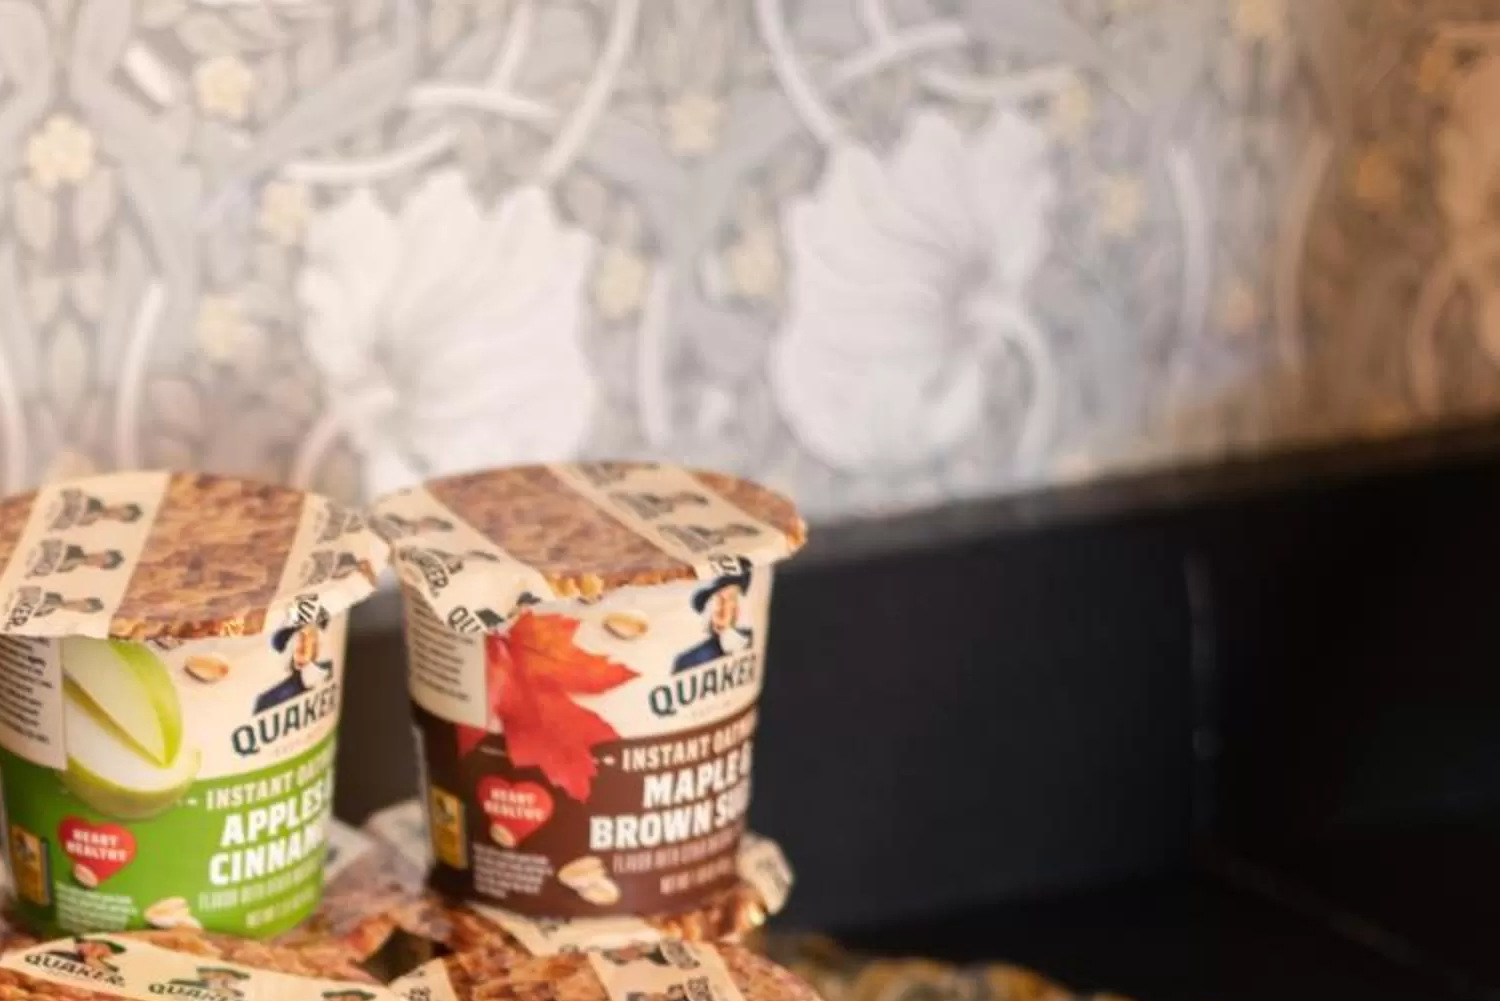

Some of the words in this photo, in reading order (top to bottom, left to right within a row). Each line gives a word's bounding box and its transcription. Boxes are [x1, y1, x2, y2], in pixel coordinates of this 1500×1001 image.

[622, 735, 711, 772] INSTANT
[205, 767, 274, 812] INSTANT
[643, 750, 740, 808] MAPLE
[589, 800, 712, 850] BROWN
[24, 953, 122, 988] QUAKER
